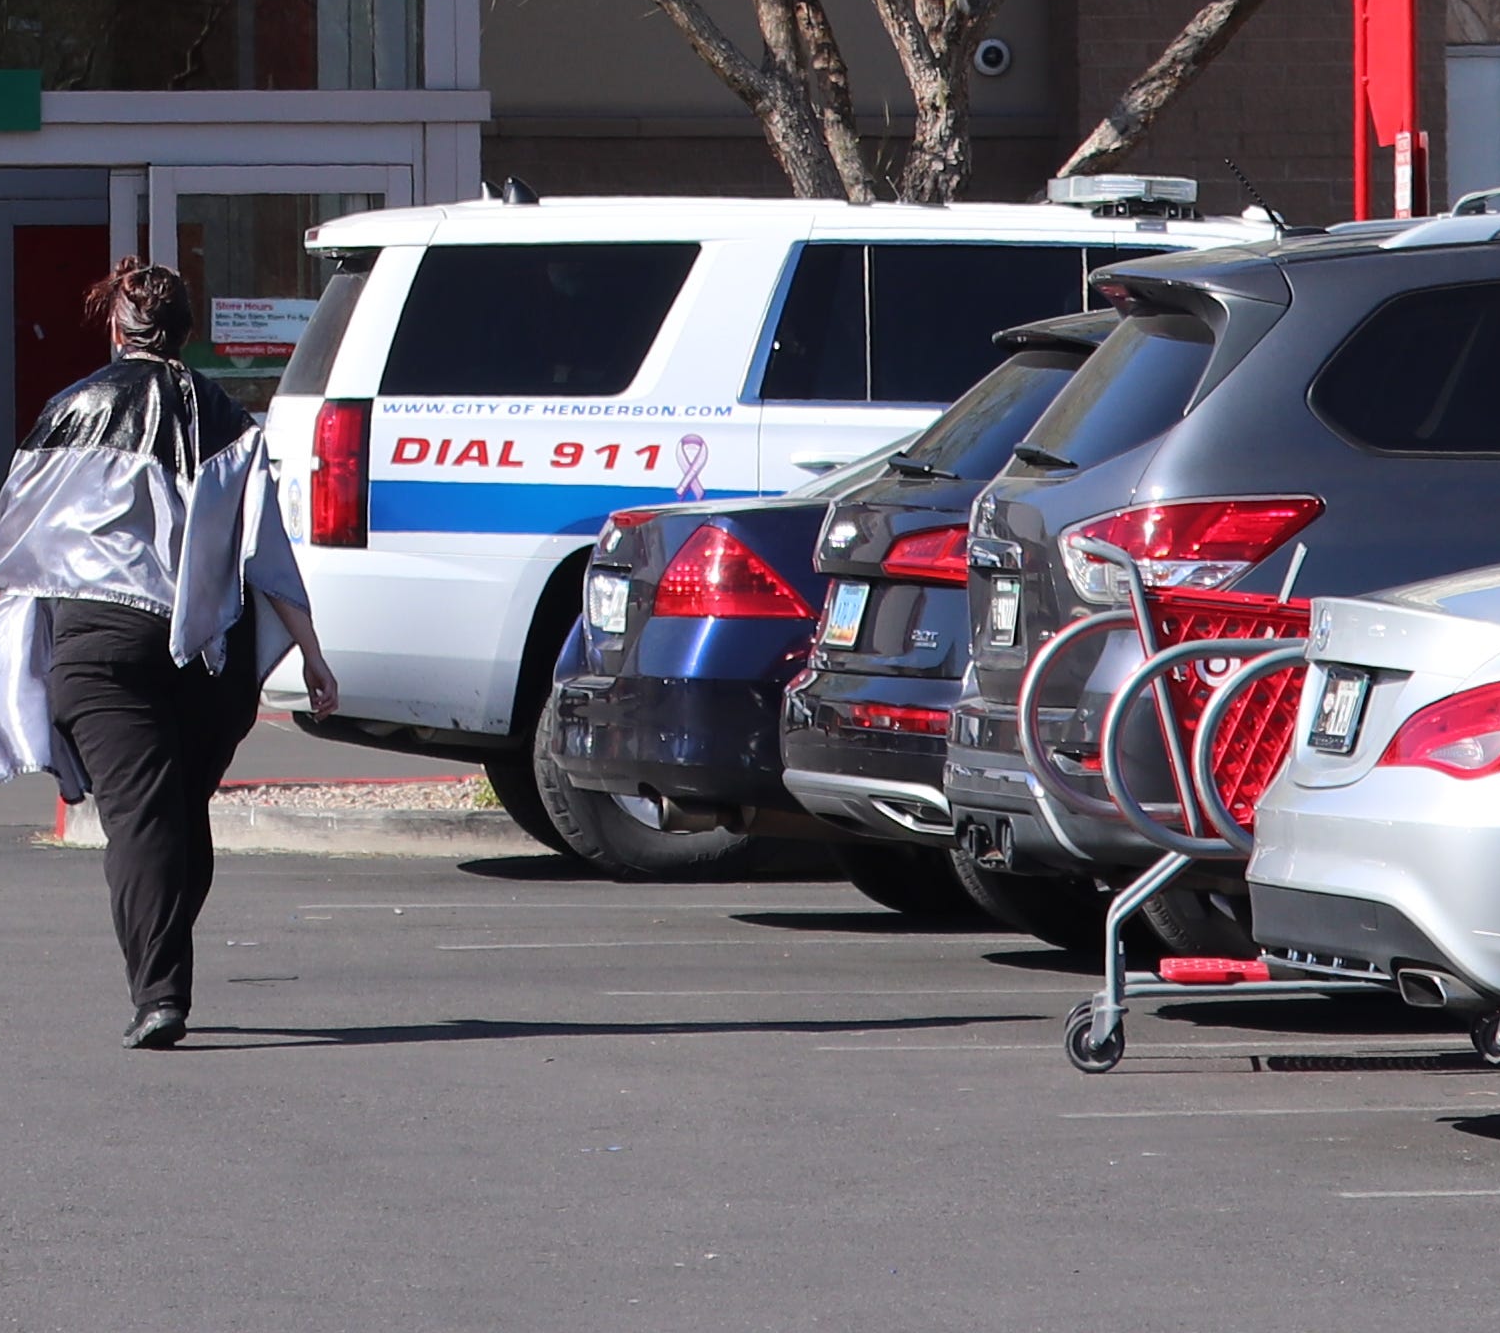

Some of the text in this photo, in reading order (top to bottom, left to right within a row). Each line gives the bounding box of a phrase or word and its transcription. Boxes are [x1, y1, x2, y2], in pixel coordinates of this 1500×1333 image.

[215, 302, 274, 312] Store Hours
[383, 403, 733, 417] WWW.CITY OF HENDERSON.COM
[390, 437, 661, 471] DIAL 911
